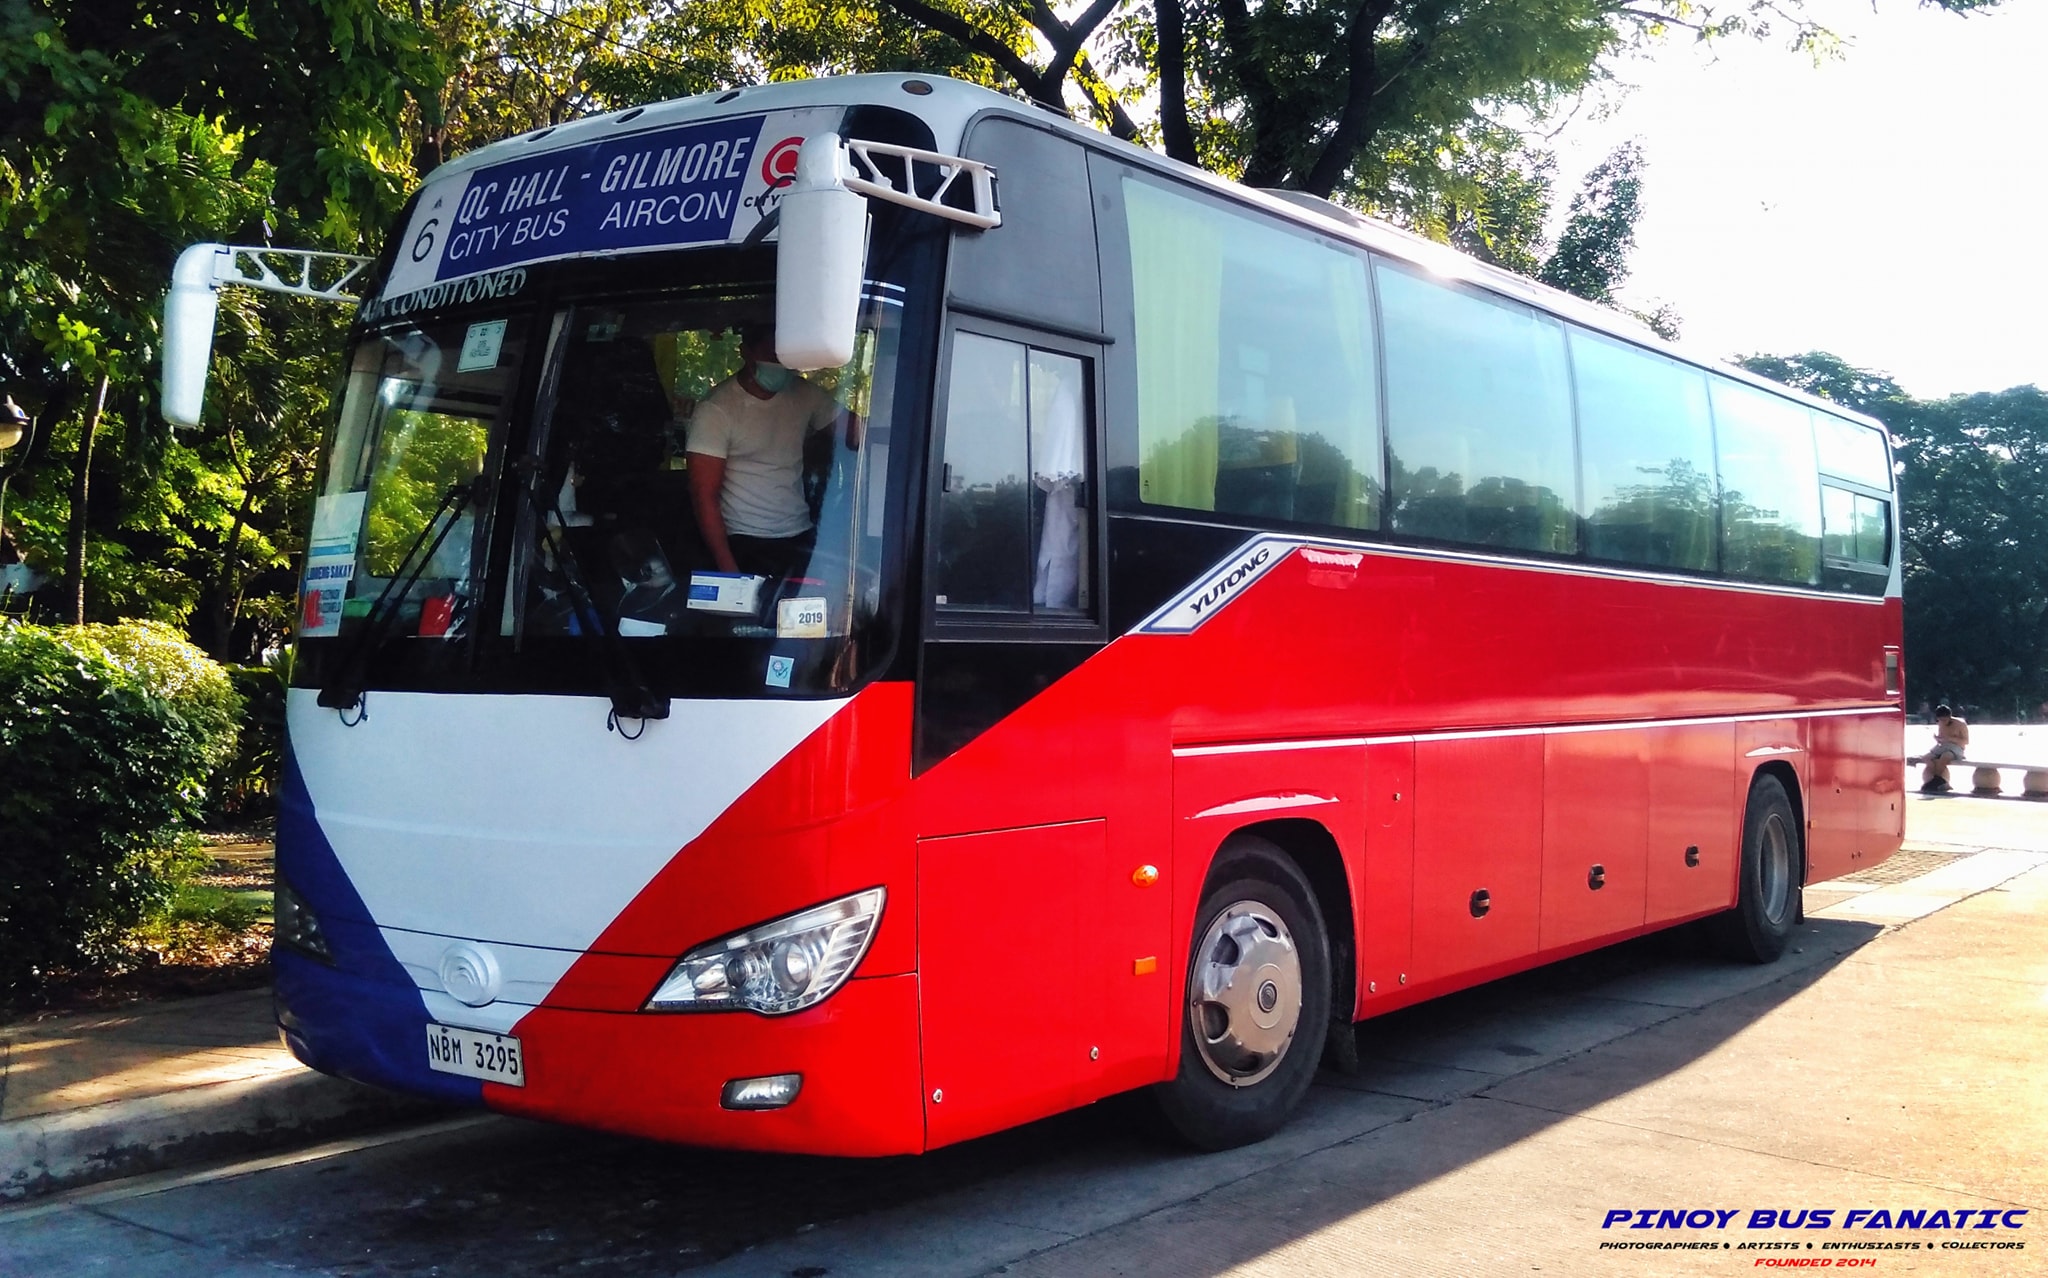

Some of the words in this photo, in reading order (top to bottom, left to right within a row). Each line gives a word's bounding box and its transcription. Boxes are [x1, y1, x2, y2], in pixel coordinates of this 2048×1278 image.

[458, 182, 498, 226] QC
[500, 165, 570, 215] HALL
[600, 136, 751, 194] GILMORE
[743, 194, 781, 208] CITY
[412, 218, 439, 263] 6
[450, 221, 511, 261] CITY
[512, 208, 570, 246] BUS
[600, 190, 733, 231] AIRCON
[391, 266, 528, 316] CONDITIONED
[1190, 548, 1270, 614] YUTONG
[798, 612, 824, 624] 2019
[430, 1034, 463, 1065] NBM
[474, 1041, 518, 1075] 3295
